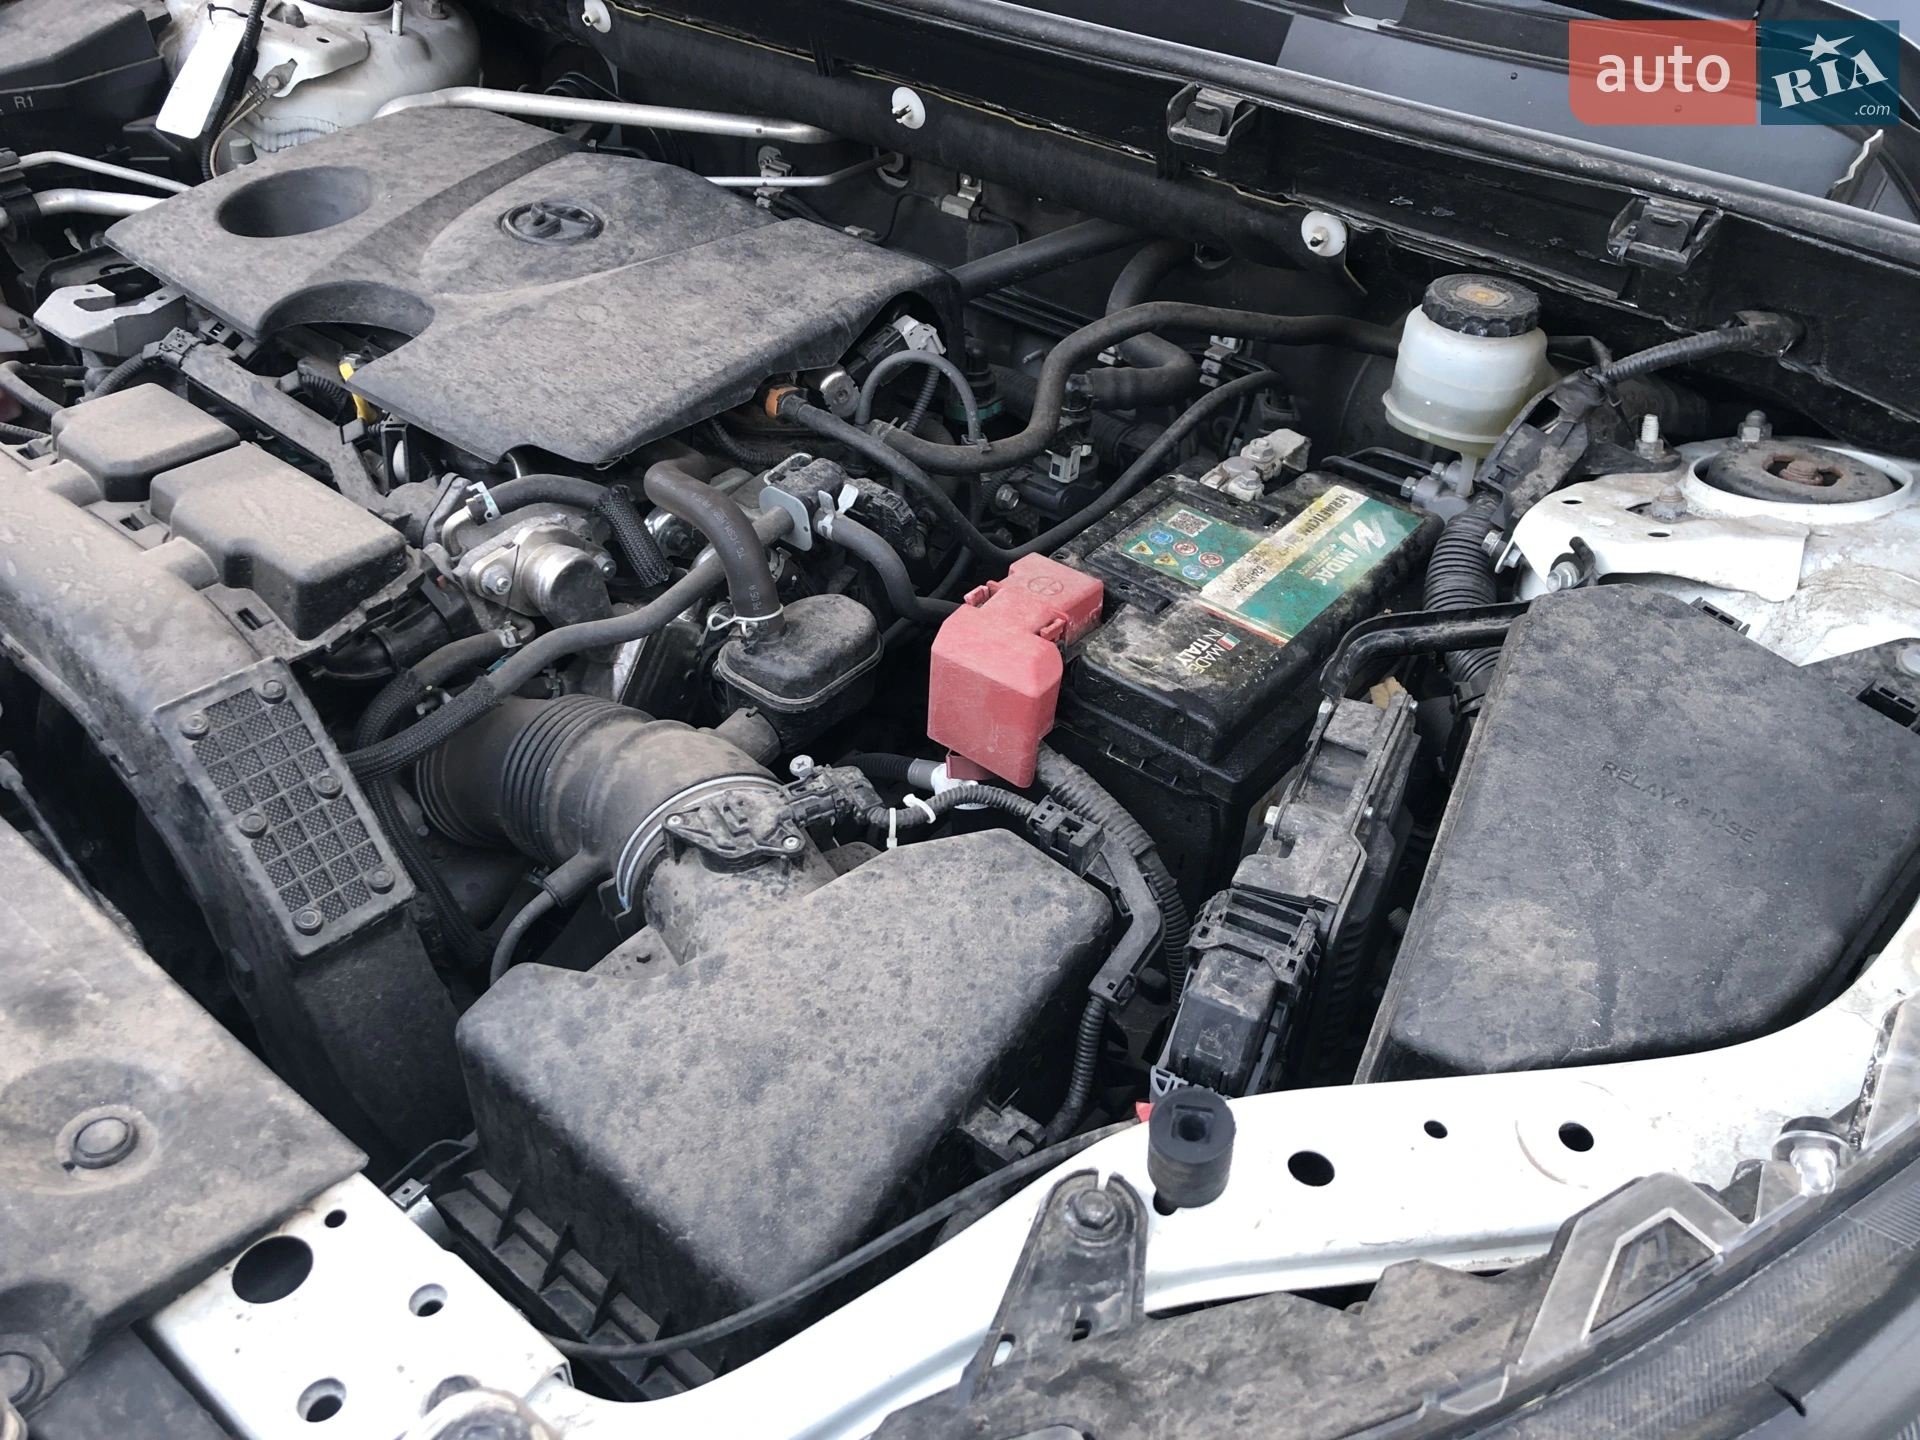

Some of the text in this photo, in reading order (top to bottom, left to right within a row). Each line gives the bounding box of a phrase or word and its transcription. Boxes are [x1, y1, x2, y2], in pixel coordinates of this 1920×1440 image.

[1174, 627, 1224, 667] IN ITALY
[1190, 643, 1226, 674] MADE
